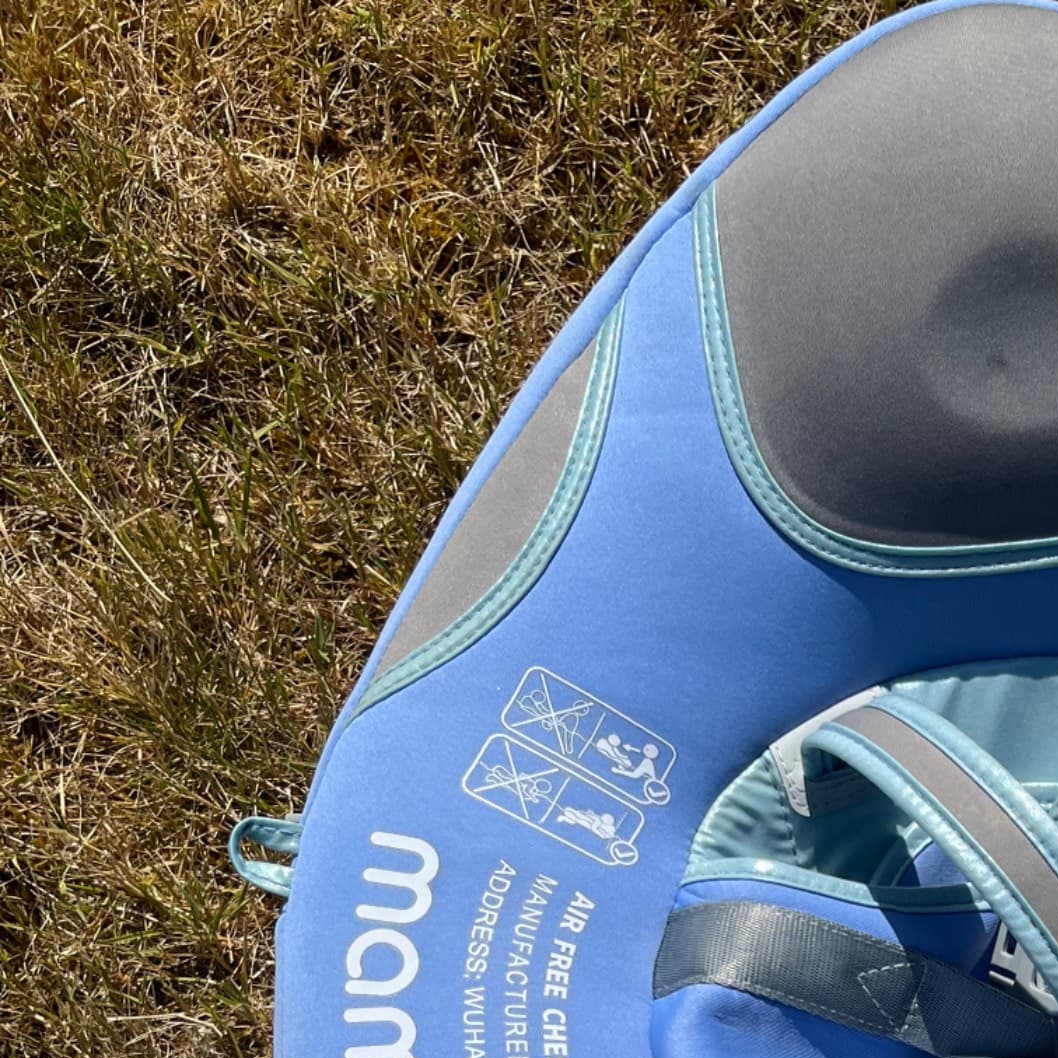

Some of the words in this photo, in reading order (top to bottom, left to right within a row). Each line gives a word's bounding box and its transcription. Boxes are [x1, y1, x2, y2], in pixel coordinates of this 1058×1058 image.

[463, 858, 518, 980] ADDRESS:
[560, 891, 595, 933] AIR
[544, 939, 576, 999] FREE
